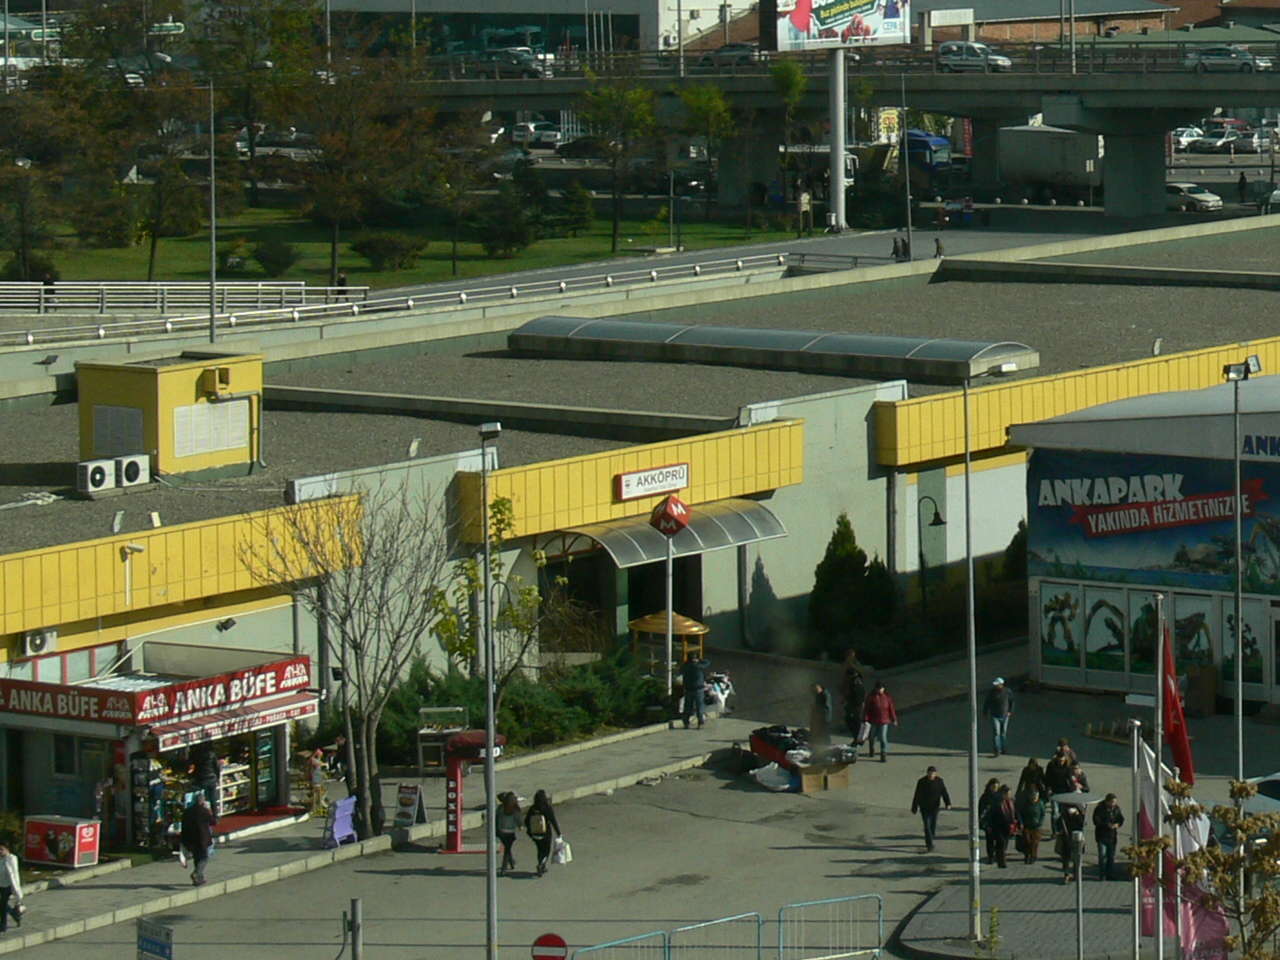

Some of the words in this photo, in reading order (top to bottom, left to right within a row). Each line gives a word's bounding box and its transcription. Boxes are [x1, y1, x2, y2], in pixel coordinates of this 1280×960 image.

[636, 466, 685, 487] AKKÖPRÜ
[1038, 473, 1185, 507] ANKAPARK
[671, 503, 686, 516] M
[1087, 507, 1150, 534] YAKINDA
[660, 519, 677, 530] M
[9, 689, 54, 714] ANKA
[57, 690, 99, 719] BÜFE
[173, 683, 226, 714] ANKA
[230, 671, 276, 702] BÜFE
[448, 781, 457, 832] BOXER
